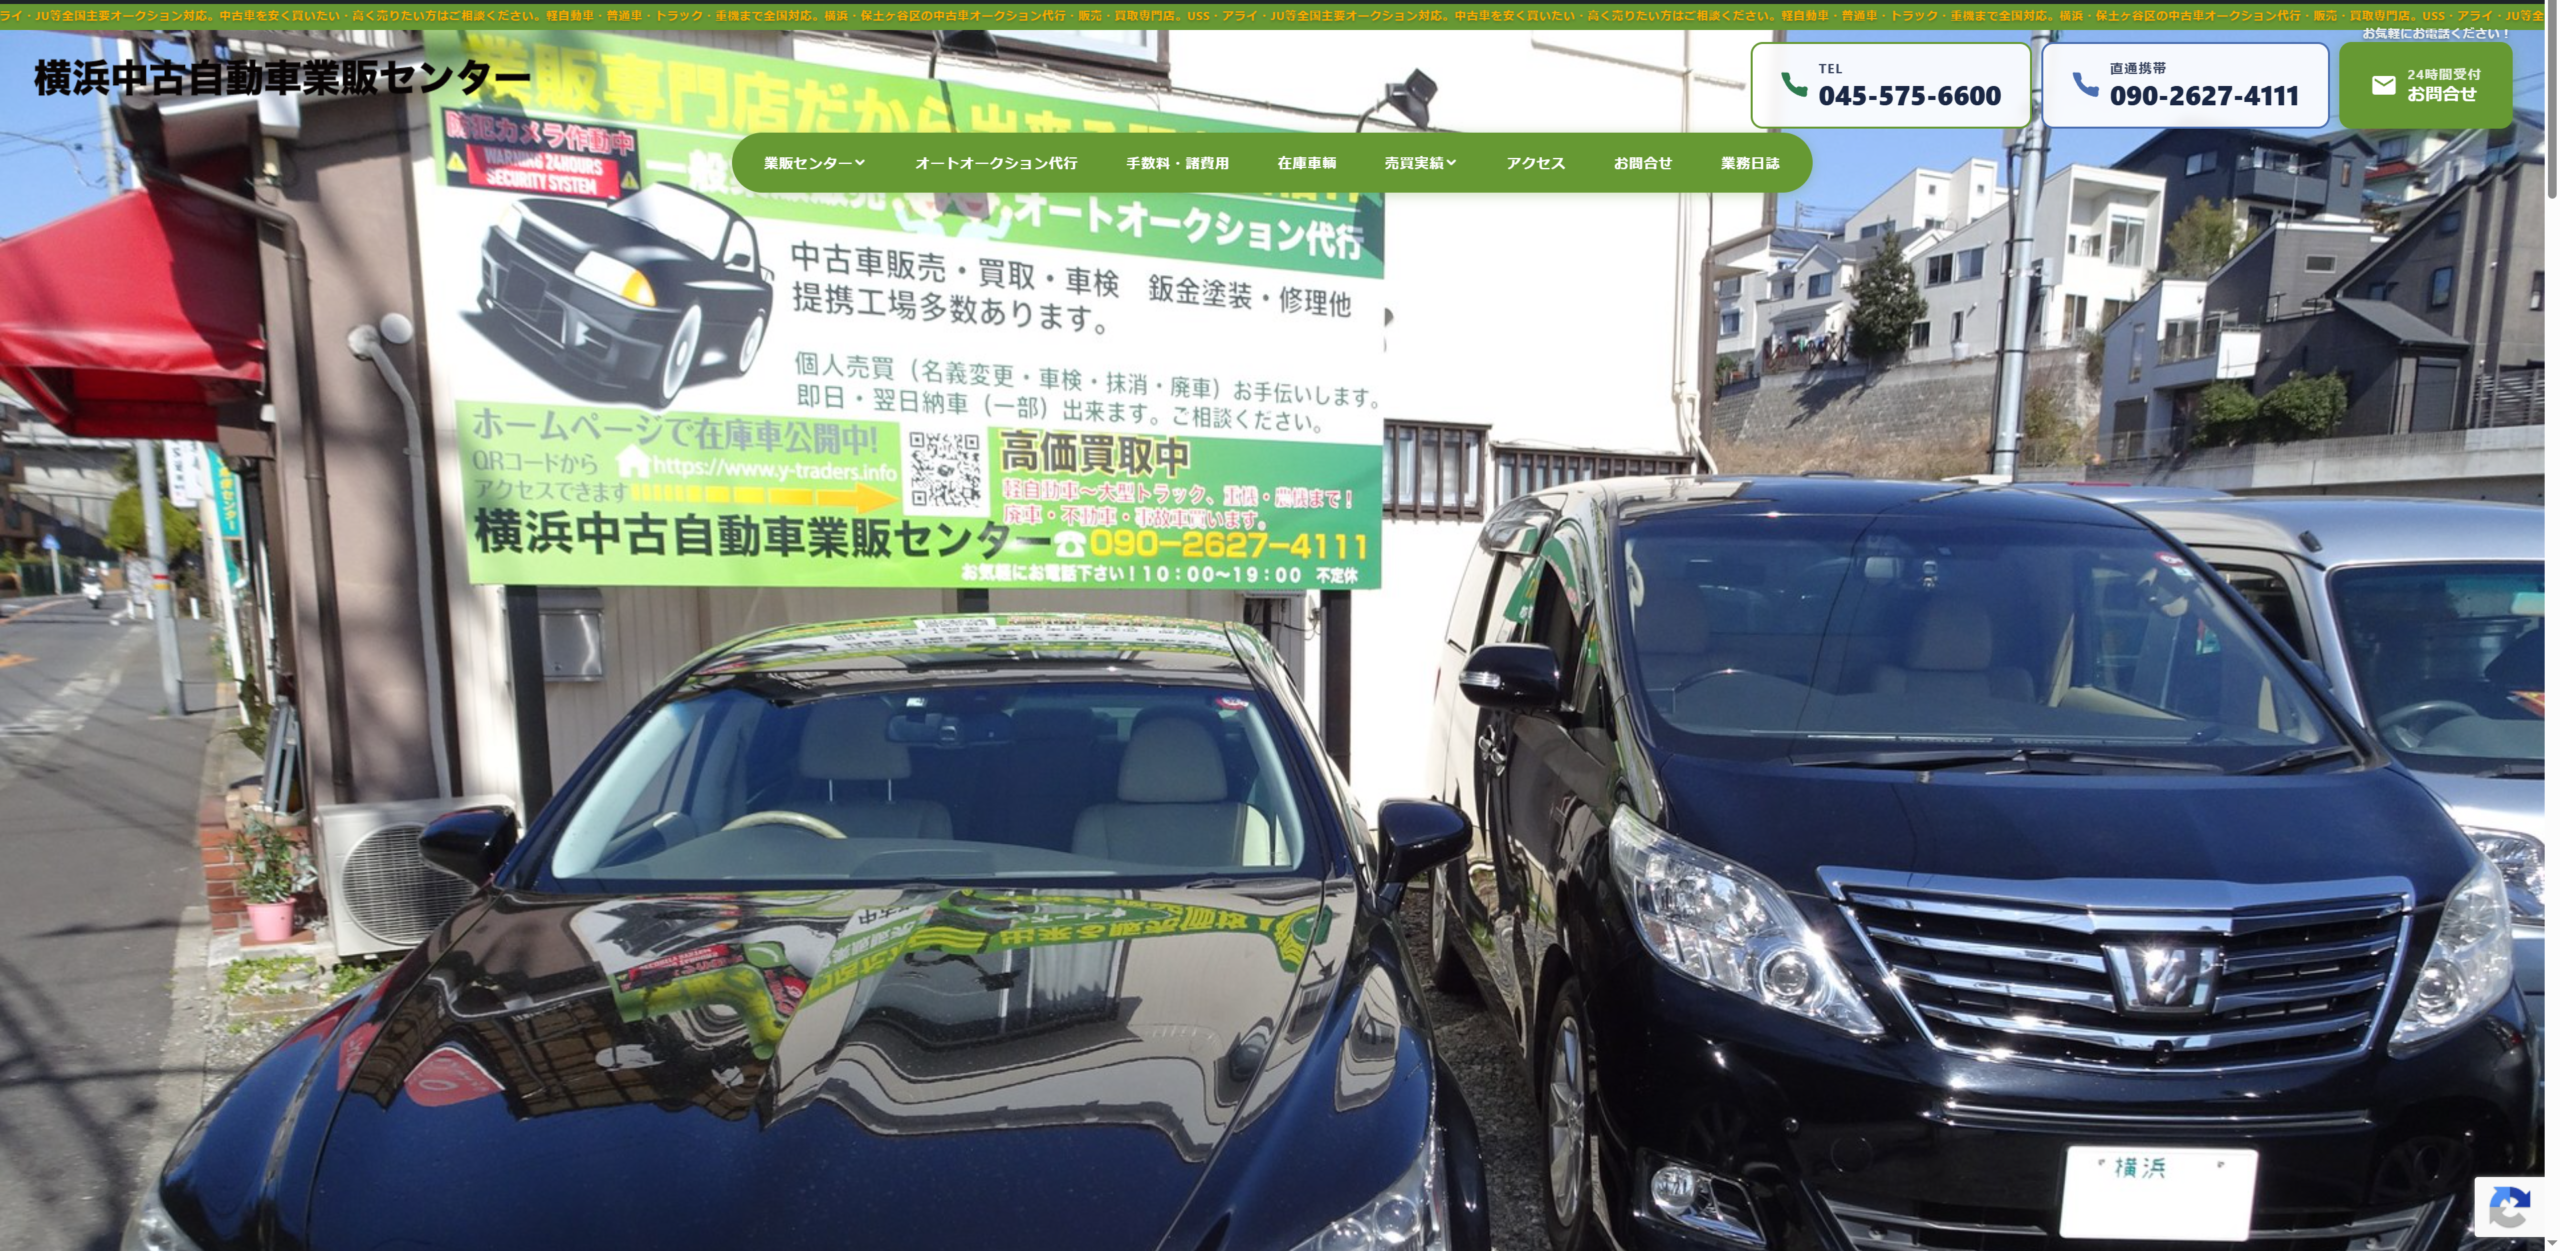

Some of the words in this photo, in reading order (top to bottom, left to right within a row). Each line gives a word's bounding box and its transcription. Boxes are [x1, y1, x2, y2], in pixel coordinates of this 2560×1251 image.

[445, 111, 635, 157] 防犯カメラ作動中
[484, 147, 543, 170] WARNING
[545, 154, 604, 177] 24HOURS
[486, 168, 547, 190] SECURITY
[548, 177, 598, 196] SYSTEM
[1014, 193, 1365, 261] オートオークション代行
[791, 241, 1120, 298] 中古車販売・買取・車検
[1149, 274, 1352, 318] 鈑金塗装・修理他
[792, 281, 1107, 335] 提携工場多数あります。
[473, 451, 598, 476] QRコードから
[653, 453, 898, 483] https://www.y-traders.info
[1000, 430, 1191, 477] 高価買取中
[475, 478, 630, 504] アクセスできます
[474, 507, 1052, 559] 横浜中古自動車業販センター
[1316, 564, 1359, 585] 不定休
[2115, 1157, 2166, 1179] 横浜
